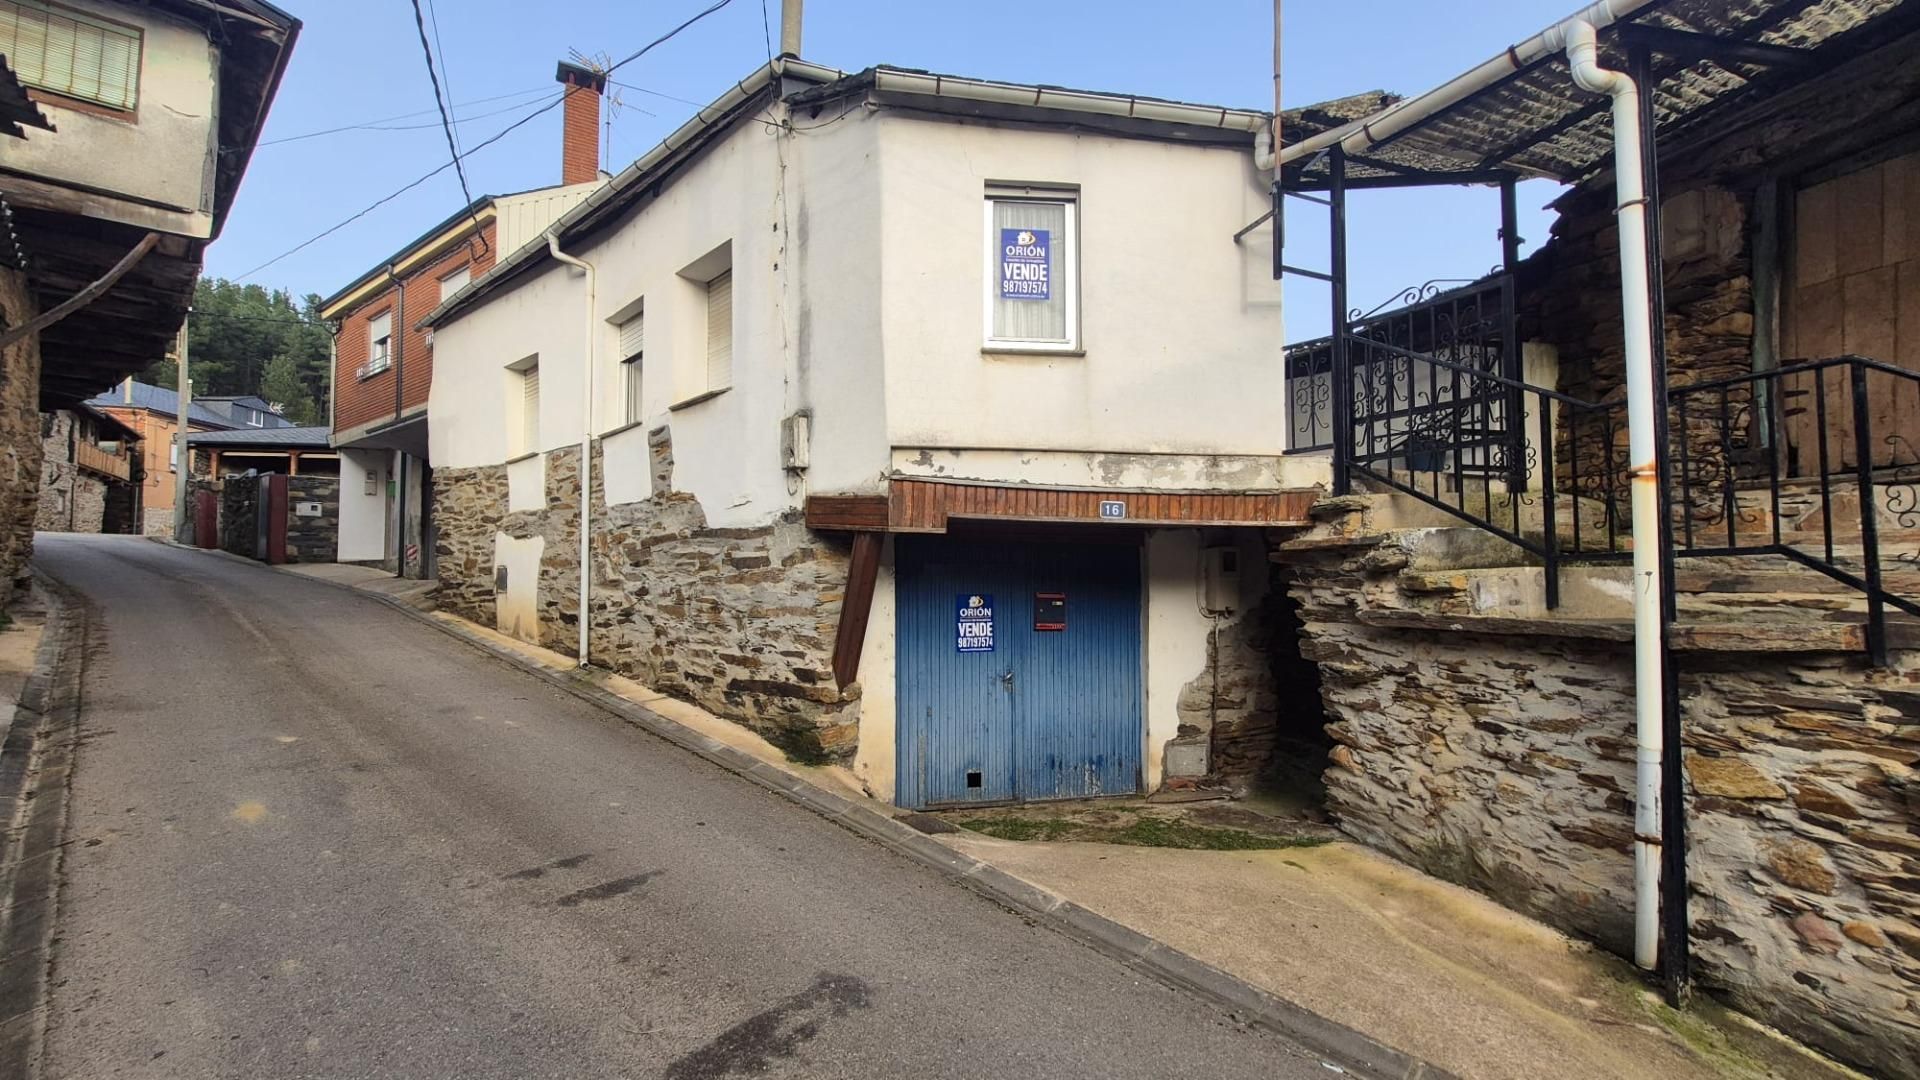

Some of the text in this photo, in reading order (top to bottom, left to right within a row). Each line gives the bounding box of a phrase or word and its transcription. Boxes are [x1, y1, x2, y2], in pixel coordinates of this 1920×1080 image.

[1006, 245, 1045, 257] ORIÓN
[1004, 263, 1048, 281] VENDE
[1003, 280, 1047, 294] 987197574
[1105, 504, 1119, 516] 16
[960, 607, 991, 617] ORIÓN
[958, 622, 993, 637] VENDE
[958, 637, 993, 648] 987197574
